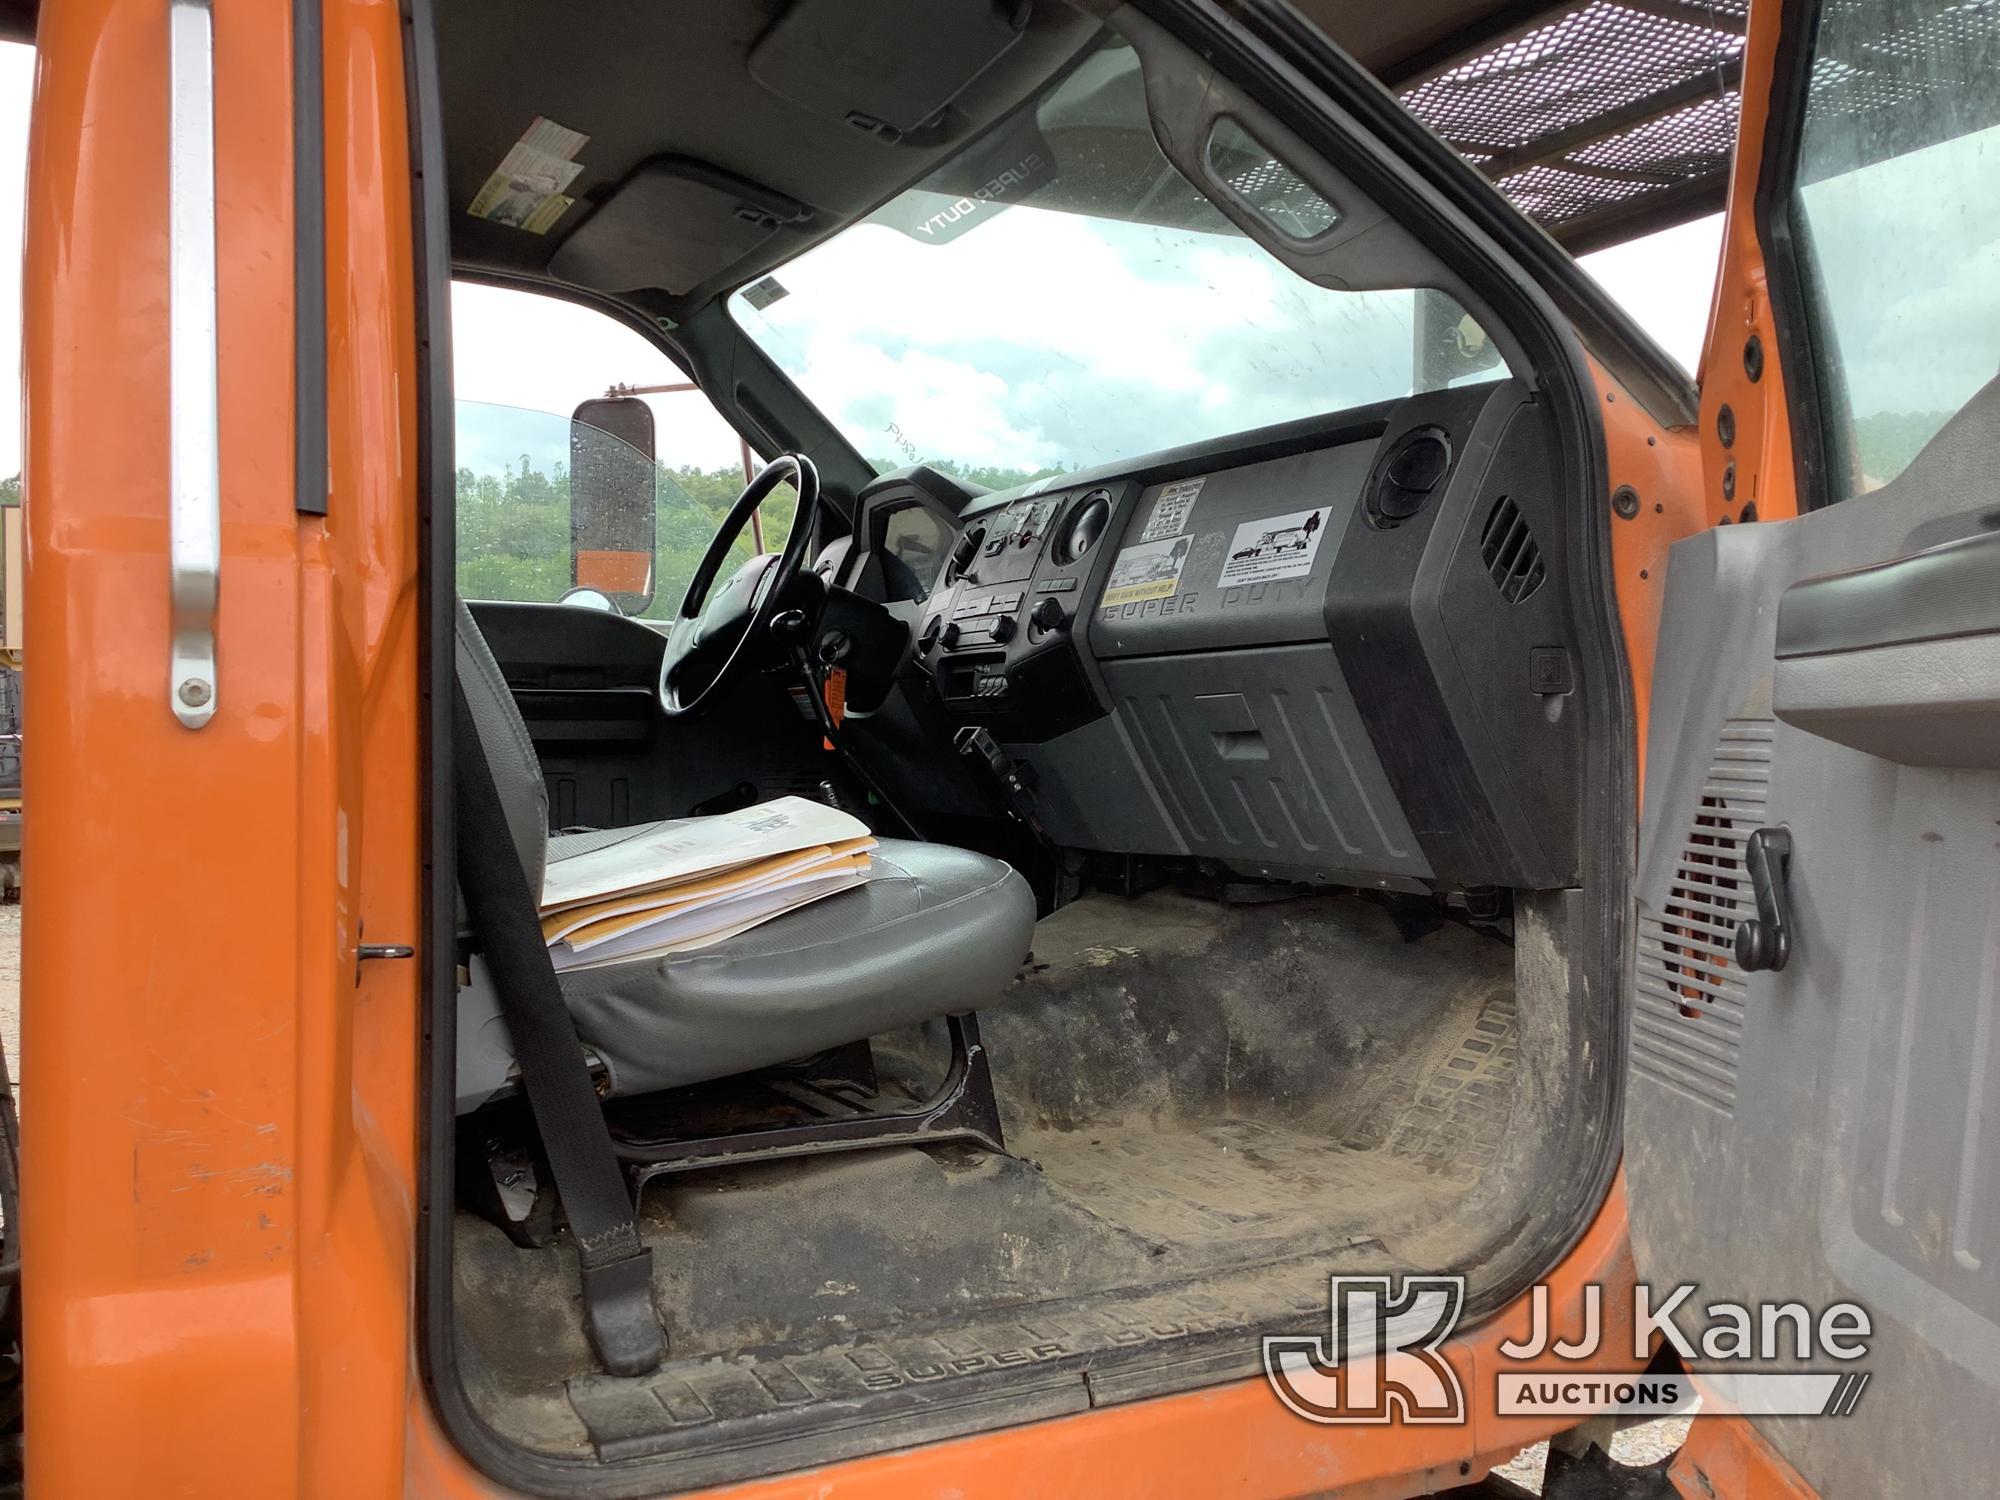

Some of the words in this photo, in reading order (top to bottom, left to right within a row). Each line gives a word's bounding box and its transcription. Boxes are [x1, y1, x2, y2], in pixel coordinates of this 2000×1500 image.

[1103, 592, 1199, 621] SUPER
[1221, 578, 1313, 609] DUTY
[862, 1342, 1068, 1391] SUPER
